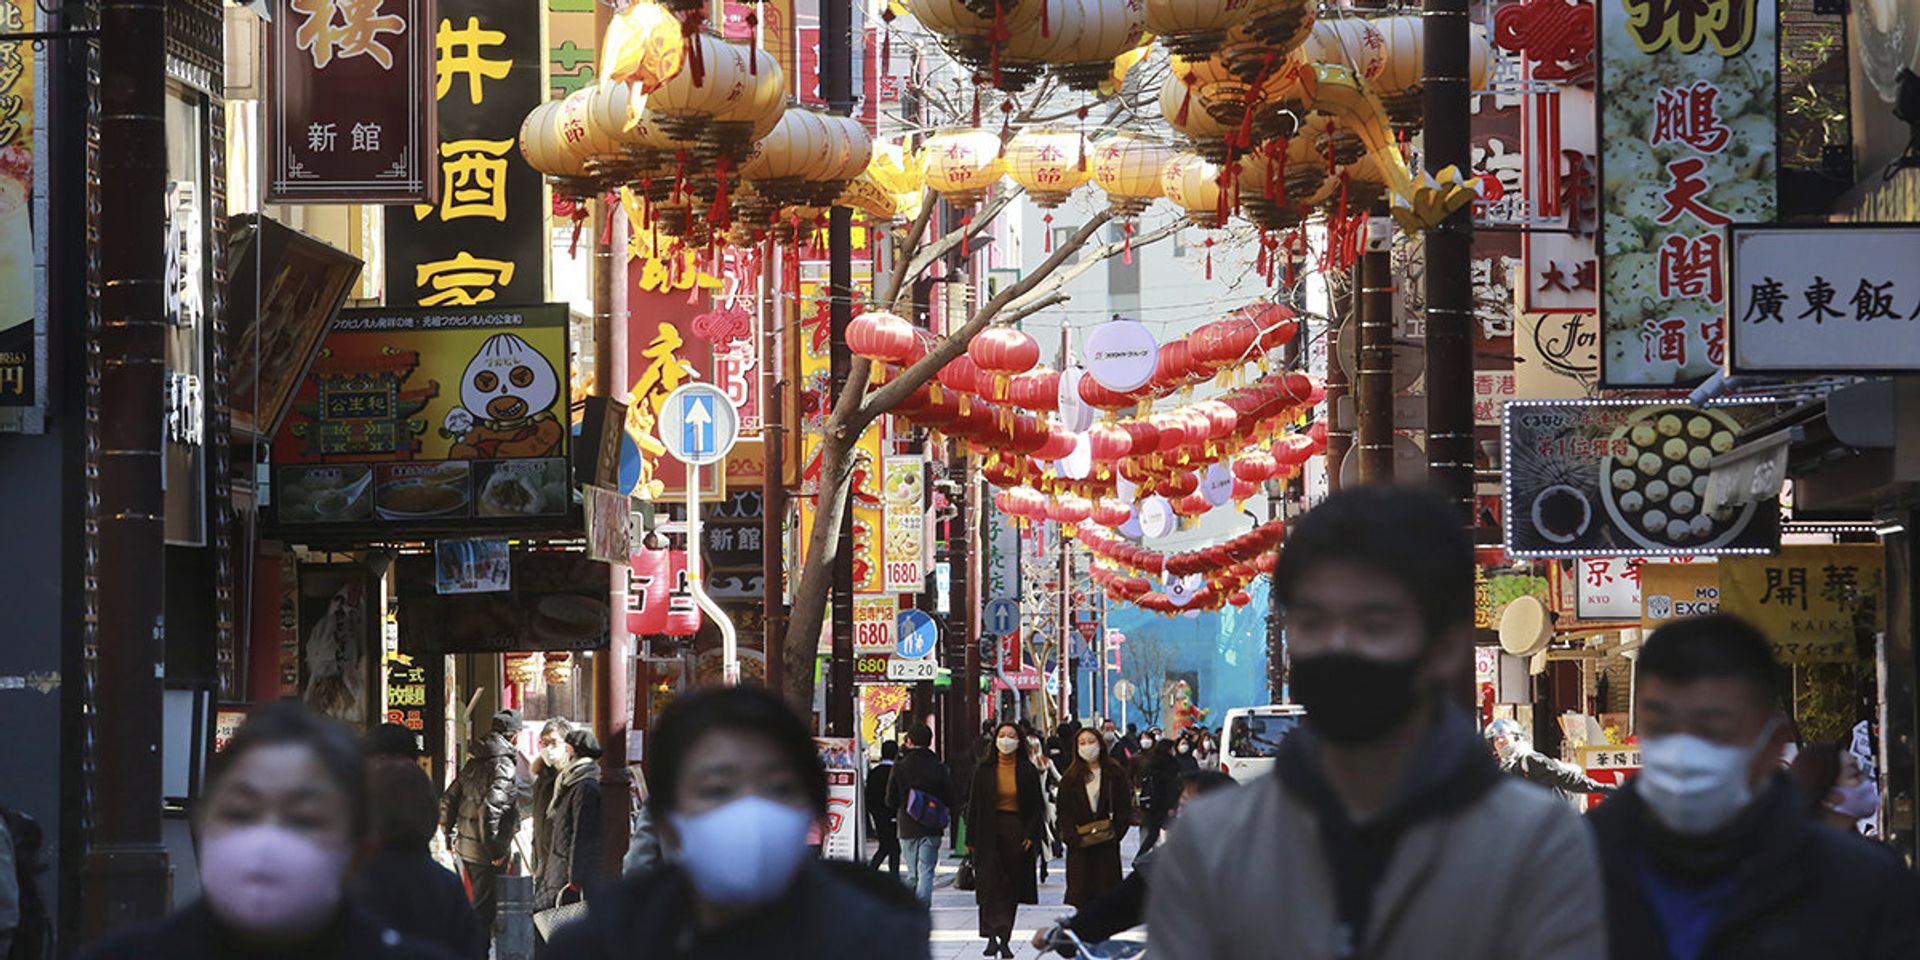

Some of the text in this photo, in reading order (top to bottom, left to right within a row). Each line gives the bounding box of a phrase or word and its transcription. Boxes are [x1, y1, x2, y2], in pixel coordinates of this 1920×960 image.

[307, 122, 382, 152] 新館
[947, 143, 972, 183] 春節
[1037, 144, 1064, 184] 春節
[1099, 144, 1121, 184] 春節
[1652, 81, 1733, 304] 鵬天閣
[1643, 317, 1725, 367] 酒家
[1475, 375, 1516, 395] 香港
[710, 527, 760, 551] 新館
[887, 563, 917, 583] 1680
[1588, 595, 1610, 604] KYO
[1696, 589, 1718, 598] MO
[853, 622, 888, 645] 1680
[858, 658, 886, 673] 680
